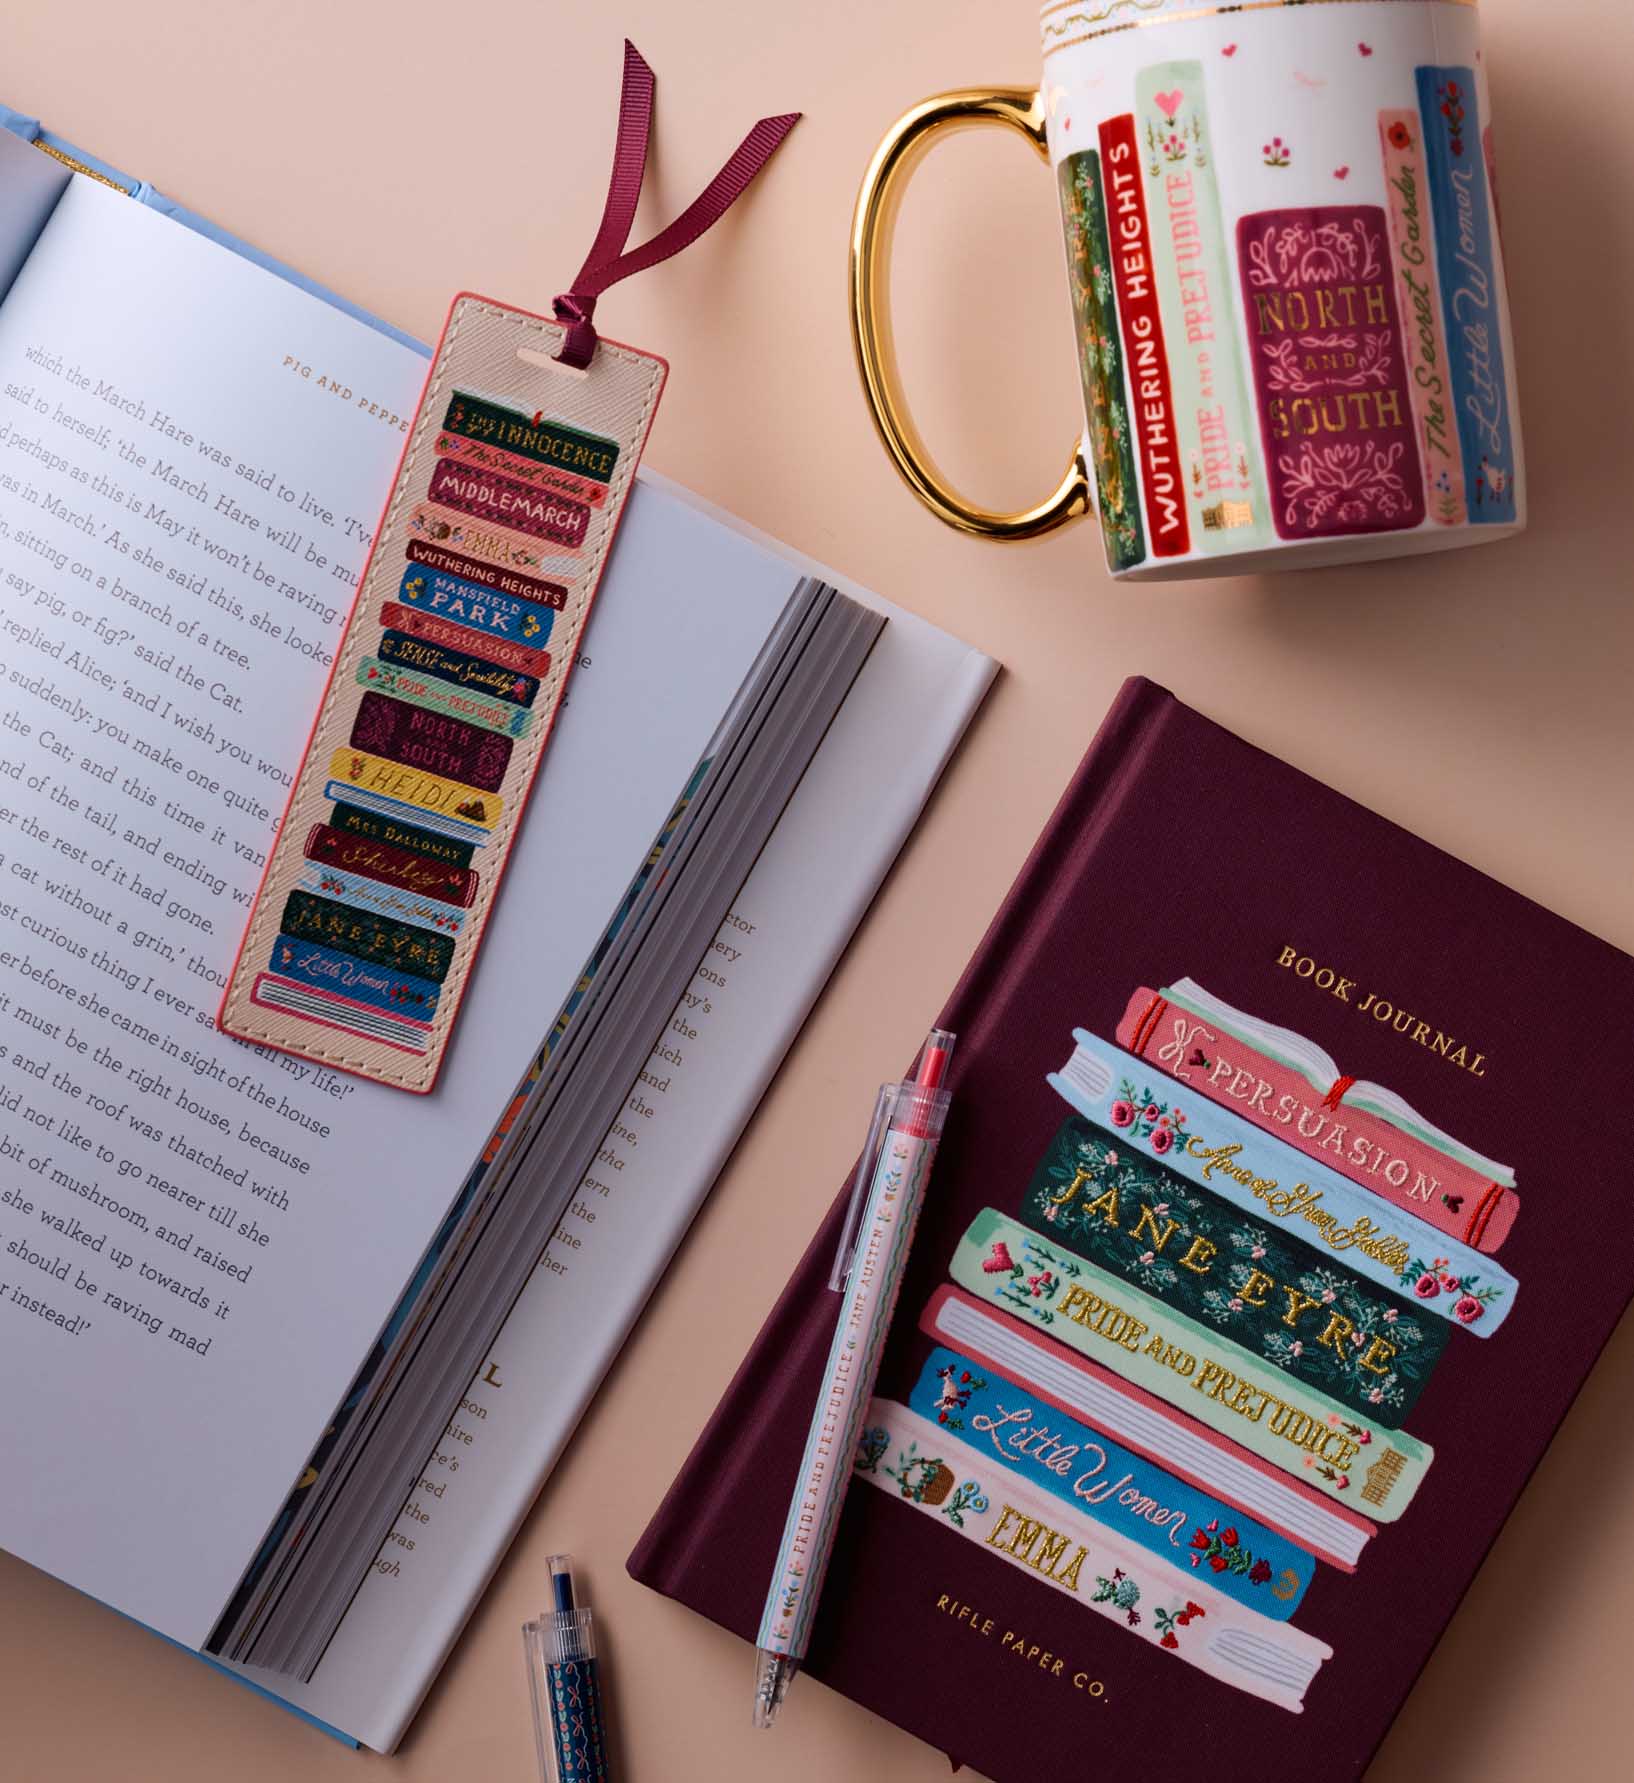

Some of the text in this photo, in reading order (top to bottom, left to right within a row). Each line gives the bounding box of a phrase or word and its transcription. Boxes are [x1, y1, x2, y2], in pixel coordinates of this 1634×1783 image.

[1165, 169, 1216, 345] PREJUDICE
[1109, 141, 1179, 534] WUTHERING HEIGHTS
[1253, 285, 1390, 336] NORTH
[1394, 166, 1452, 457] The Secret Garden
[1453, 166, 1500, 454] Little Women
[282, 355, 410, 433] PIG AND PEPPE
[1304, 351, 1357, 371] AND
[25, 345, 335, 528] which the March Hare was said to live.
[498, 421, 612, 473] INNOCENCE
[1197, 404, 1234, 493] PRIDE
[1271, 390, 1403, 440] SOUTH
[4, 383, 35, 406] said
[33, 397, 49, 415] to
[150, 459, 209, 504] March
[213, 494, 260, 531] Hare
[266, 526, 303, 553] will
[304, 541, 328, 569] be
[439, 475, 581, 531] MIDDLEMARCH
[413, 545, 561, 606] WUTHERING HEIGHTS
[463, 529, 511, 562] EMMA
[430, 592, 512, 631] PARK
[434, 577, 521, 615] MANSFIELD
[5, 573, 36, 597] say
[33, 589, 67, 617] pig,
[71, 610, 93, 627] or
[133, 645, 176, 673] said
[175, 664, 206, 691] the
[209, 682, 243, 714] Cat.
[394, 641, 445, 669] SENSE
[396, 676, 429, 697] PRIDE
[422, 622, 523, 664] PERSUASION
[2, 618, 66, 660] replied
[159, 701, 173, 720] I
[174, 713, 215, 745] wish
[215, 738, 253, 766] you
[410, 711, 472, 746] NORTH
[2, 711, 32, 737] the
[79, 757, 119, 784] and
[121, 777, 157, 807] this
[163, 801, 205, 834] time
[210, 826, 227, 846] it
[370, 766, 455, 810] HEIDI
[400, 740, 463, 773] SOUTH
[20, 816, 214, 936] the rest of it had gone.
[296, 909, 440, 966] JANE EYRE
[297, 952, 390, 995] Little Women
[672, 1018, 697, 1040] the
[1275, 946, 1485, 1077] BOOK JOURNAL
[12, 1007, 311, 1175] must be the right house, because
[280, 1055, 310, 1081] my
[629, 1096, 654, 1119] the
[11, 1053, 289, 1212] and the roof was thatched with
[1208, 1055, 1442, 1203] PERSUASION
[0, 1134, 253, 1284] bit of mushroom, and raised
[22, 1106, 270, 1248] not like to go nearer till she
[570, 1201, 597, 1223] the
[1186, 1136, 1253, 1185] Anne
[1267, 1183, 1340, 1230] Green
[1318, 1215, 1409, 1276] Gables
[0, 1188, 231, 1320] she walked up towards it
[6, 1239, 213, 1357] should be raving mad
[1052, 1167, 1398, 1376] JANE EYRE
[793, 1229, 884, 1555] PRIDE AND PREJUDICE JANE AUSTEN
[1056, 1282, 1361, 1471] PRIDE AND PREJUDICE
[404, 1502, 431, 1525] the
[971, 1403, 1188, 1548] Little Women
[387, 1532, 416, 1551] was
[983, 1502, 1091, 1593] EMMA
[935, 1593, 1110, 1704] RIFLE PAPER CO.
